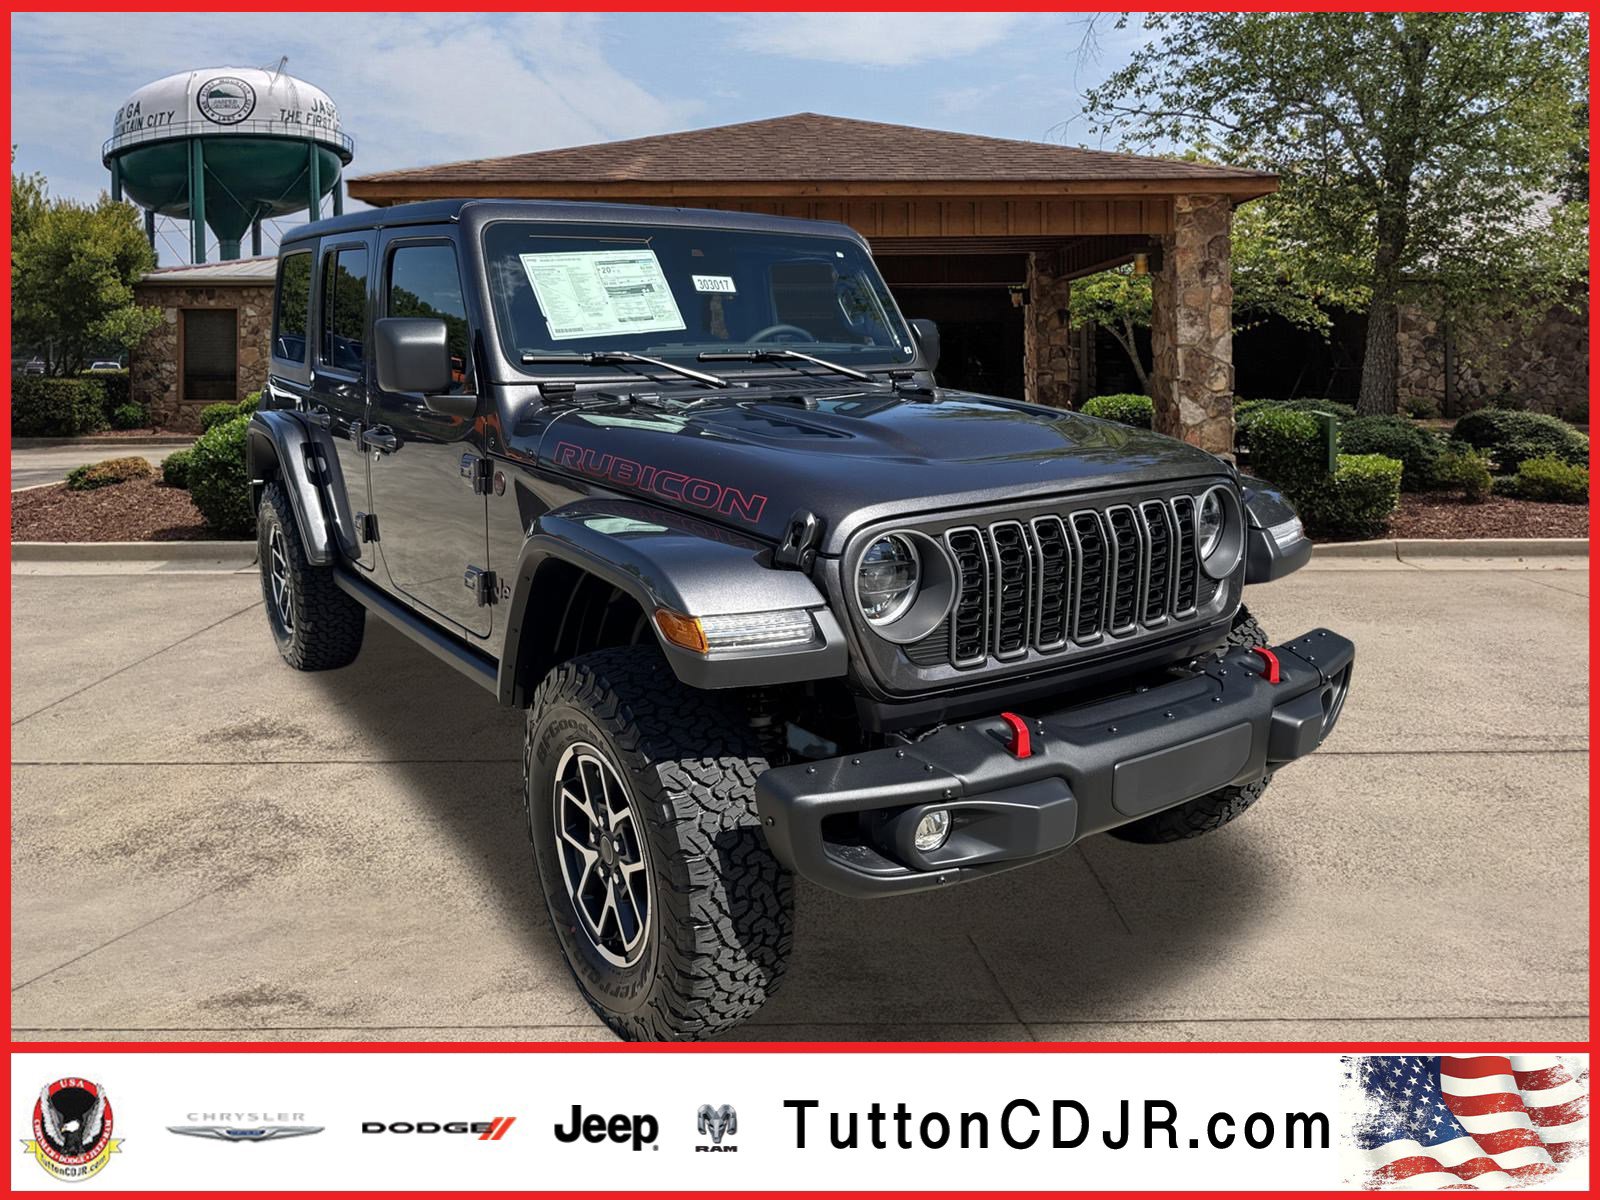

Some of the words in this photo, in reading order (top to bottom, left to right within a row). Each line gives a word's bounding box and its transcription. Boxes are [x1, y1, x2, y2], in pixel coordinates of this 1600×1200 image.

[126, 100, 141, 119] GA
[147, 110, 176, 127] CITY
[280, 108, 303, 123] THE
[306, 112, 332, 129] FIRST
[697, 279, 729, 290] 303017
[552, 441, 768, 523] RUBICON
